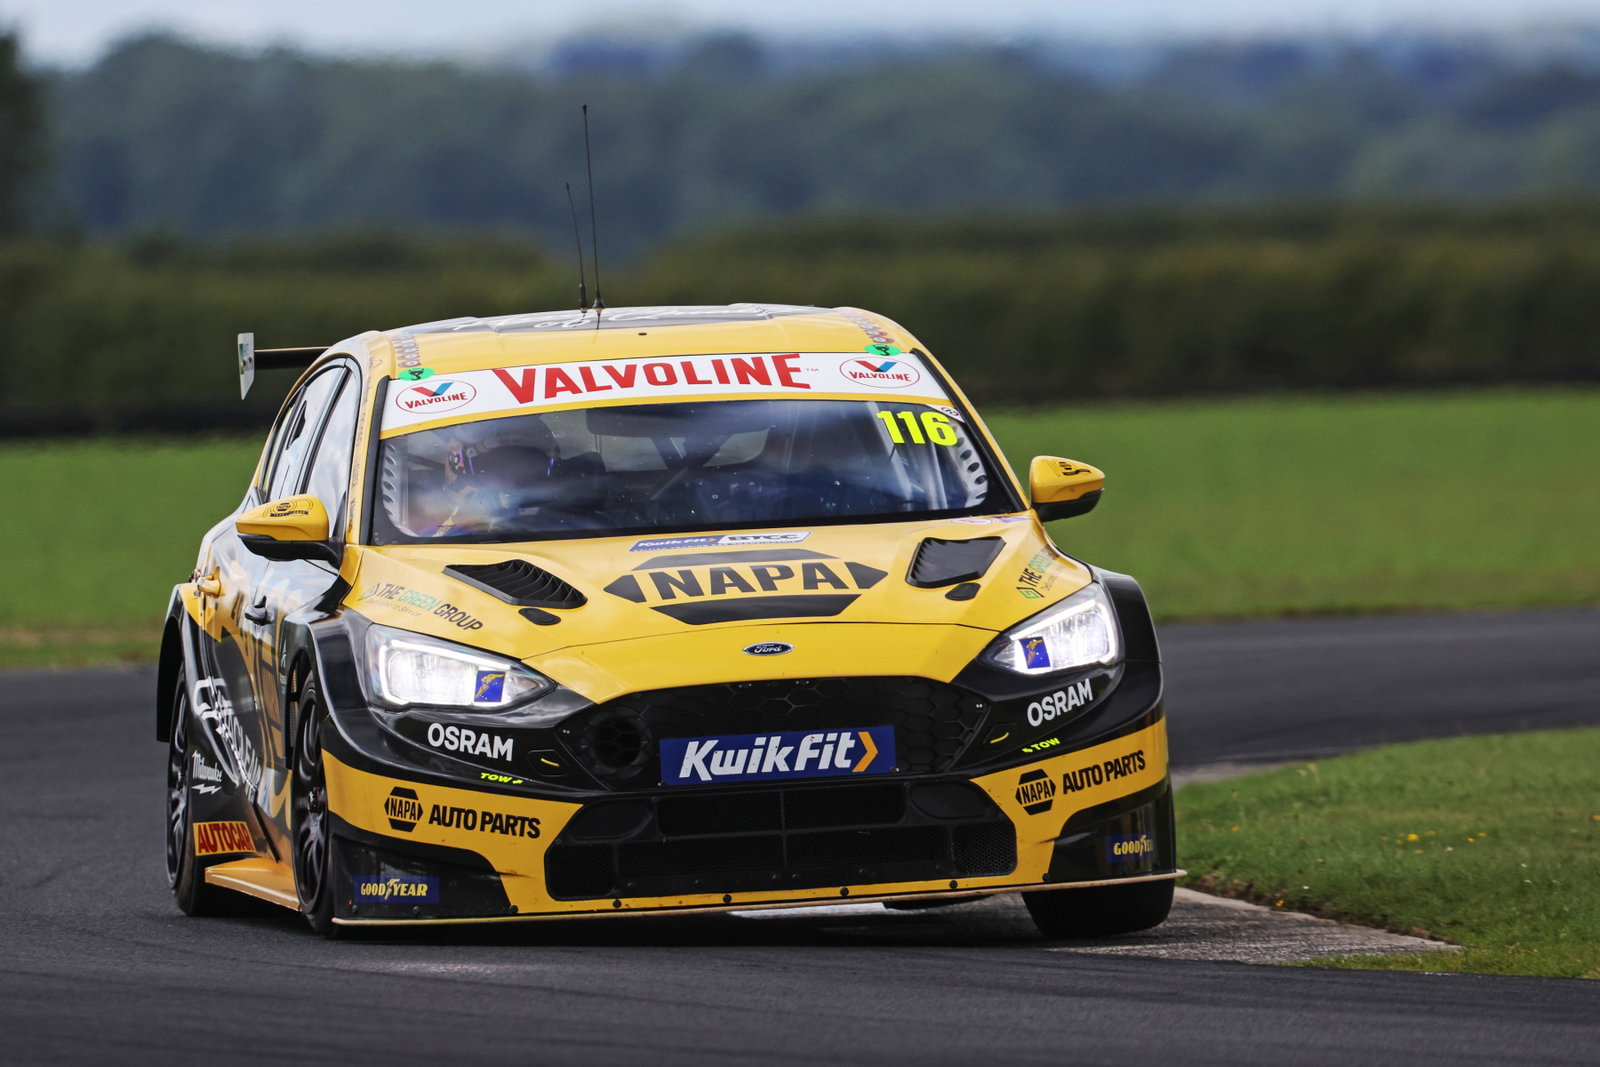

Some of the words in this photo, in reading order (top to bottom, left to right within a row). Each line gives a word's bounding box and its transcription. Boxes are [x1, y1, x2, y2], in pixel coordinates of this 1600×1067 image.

[492, 353, 811, 405] VALVOLINE
[849, 370, 912, 382] VALVOLINE
[405, 392, 468, 409] VALVOLINE
[876, 410, 957, 446] 116
[648, 562, 850, 600] NAPA
[1018, 568, 1042, 587] THE
[378, 584, 405, 600] THE
[398, 589, 443, 611] GREEN
[433, 603, 483, 631] GROUP
[754, 644, 783, 653] Ford
[1027, 678, 1093, 727] OSRAM
[427, 722, 514, 761] OSRAM
[1031, 737, 1060, 751] TOW
[480, 772, 512, 784] TOW
[1021, 780, 1051, 804] NAPA
[1062, 764, 1103, 794] AUTO
[1103, 750, 1146, 782] PARTS
[389, 797, 416, 821] NAPA
[428, 804, 477, 831] AUTO
[480, 811, 541, 839] PARTS
[197, 822, 255, 853] AUTOCAR
